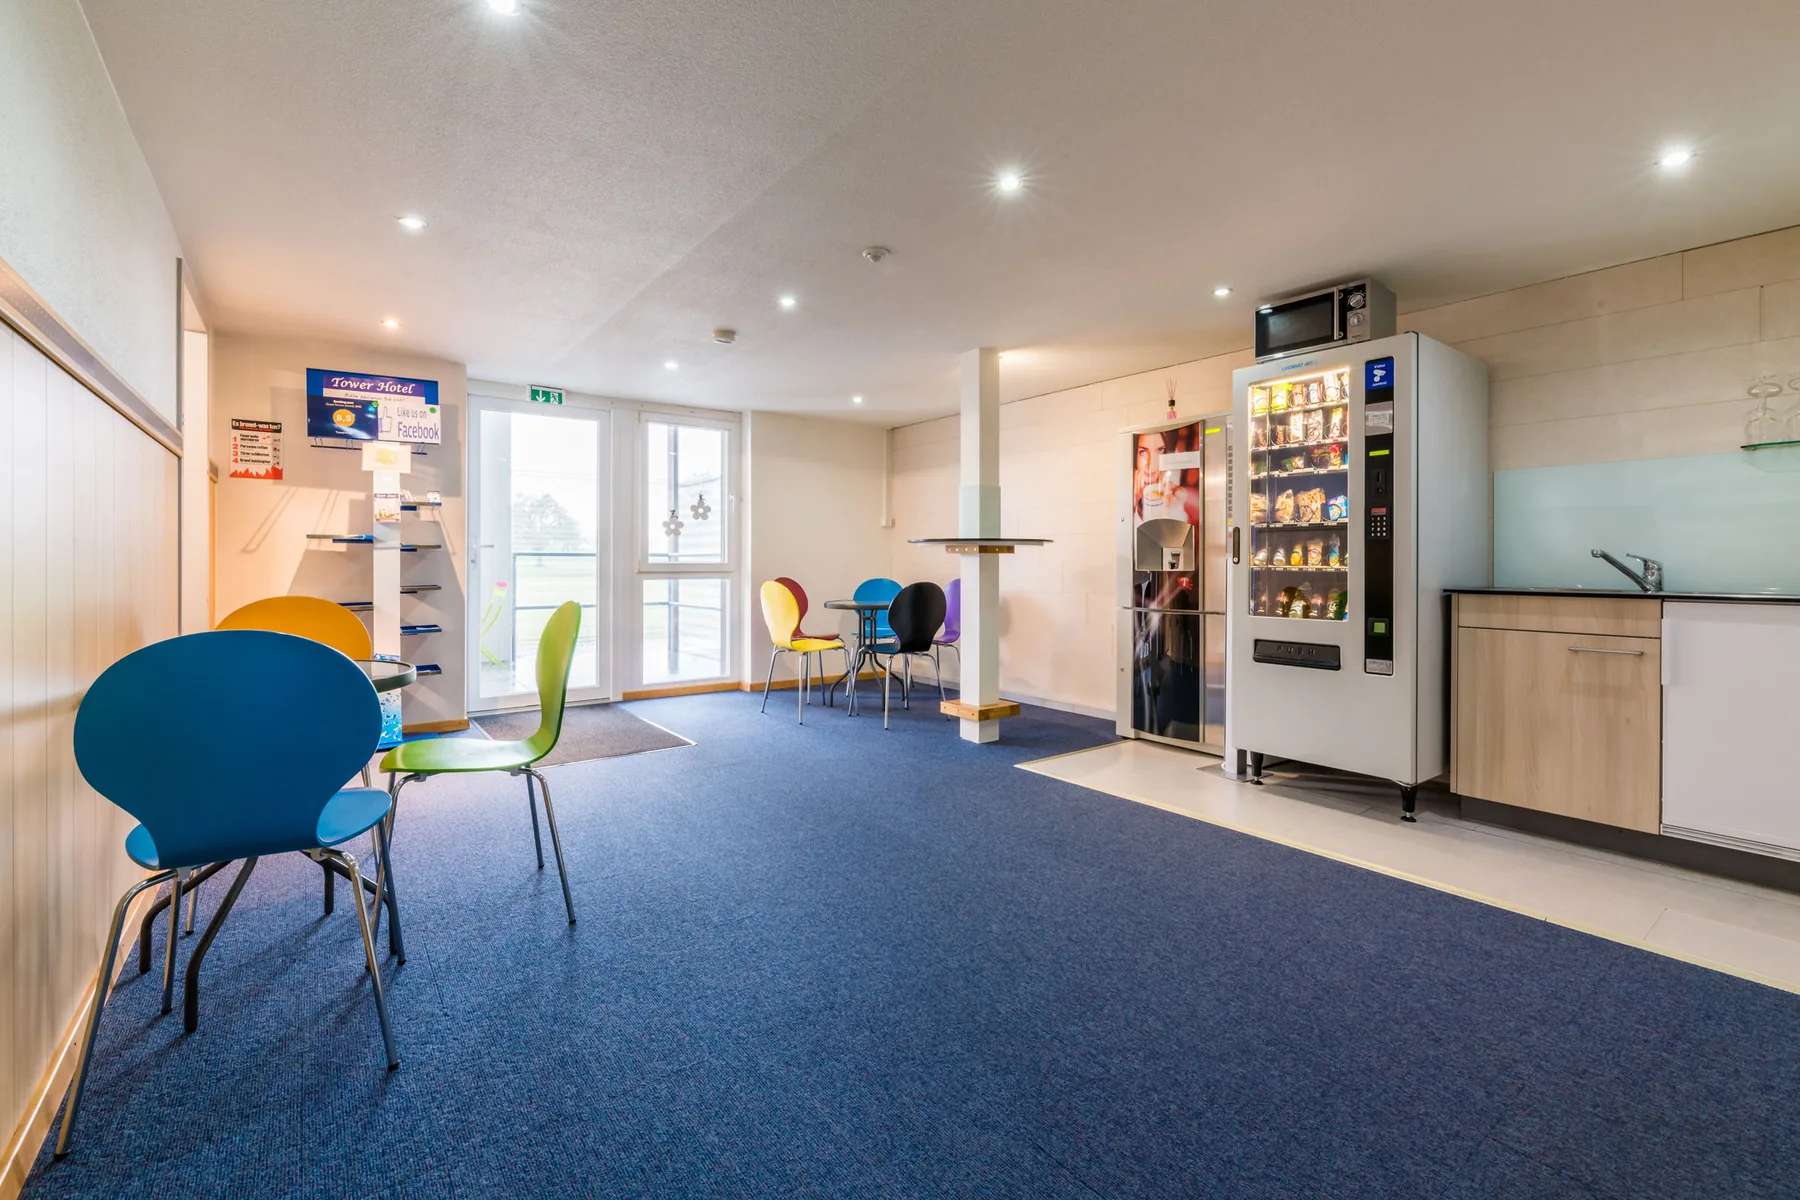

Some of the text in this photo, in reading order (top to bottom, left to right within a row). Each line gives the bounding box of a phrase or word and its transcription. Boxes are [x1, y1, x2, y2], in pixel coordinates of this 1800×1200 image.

[331, 377, 415, 394] Tower Hotel
[336, 414, 352, 423] 8,5
[397, 407, 428, 419] Like us on
[397, 422, 440, 440] Facebook
